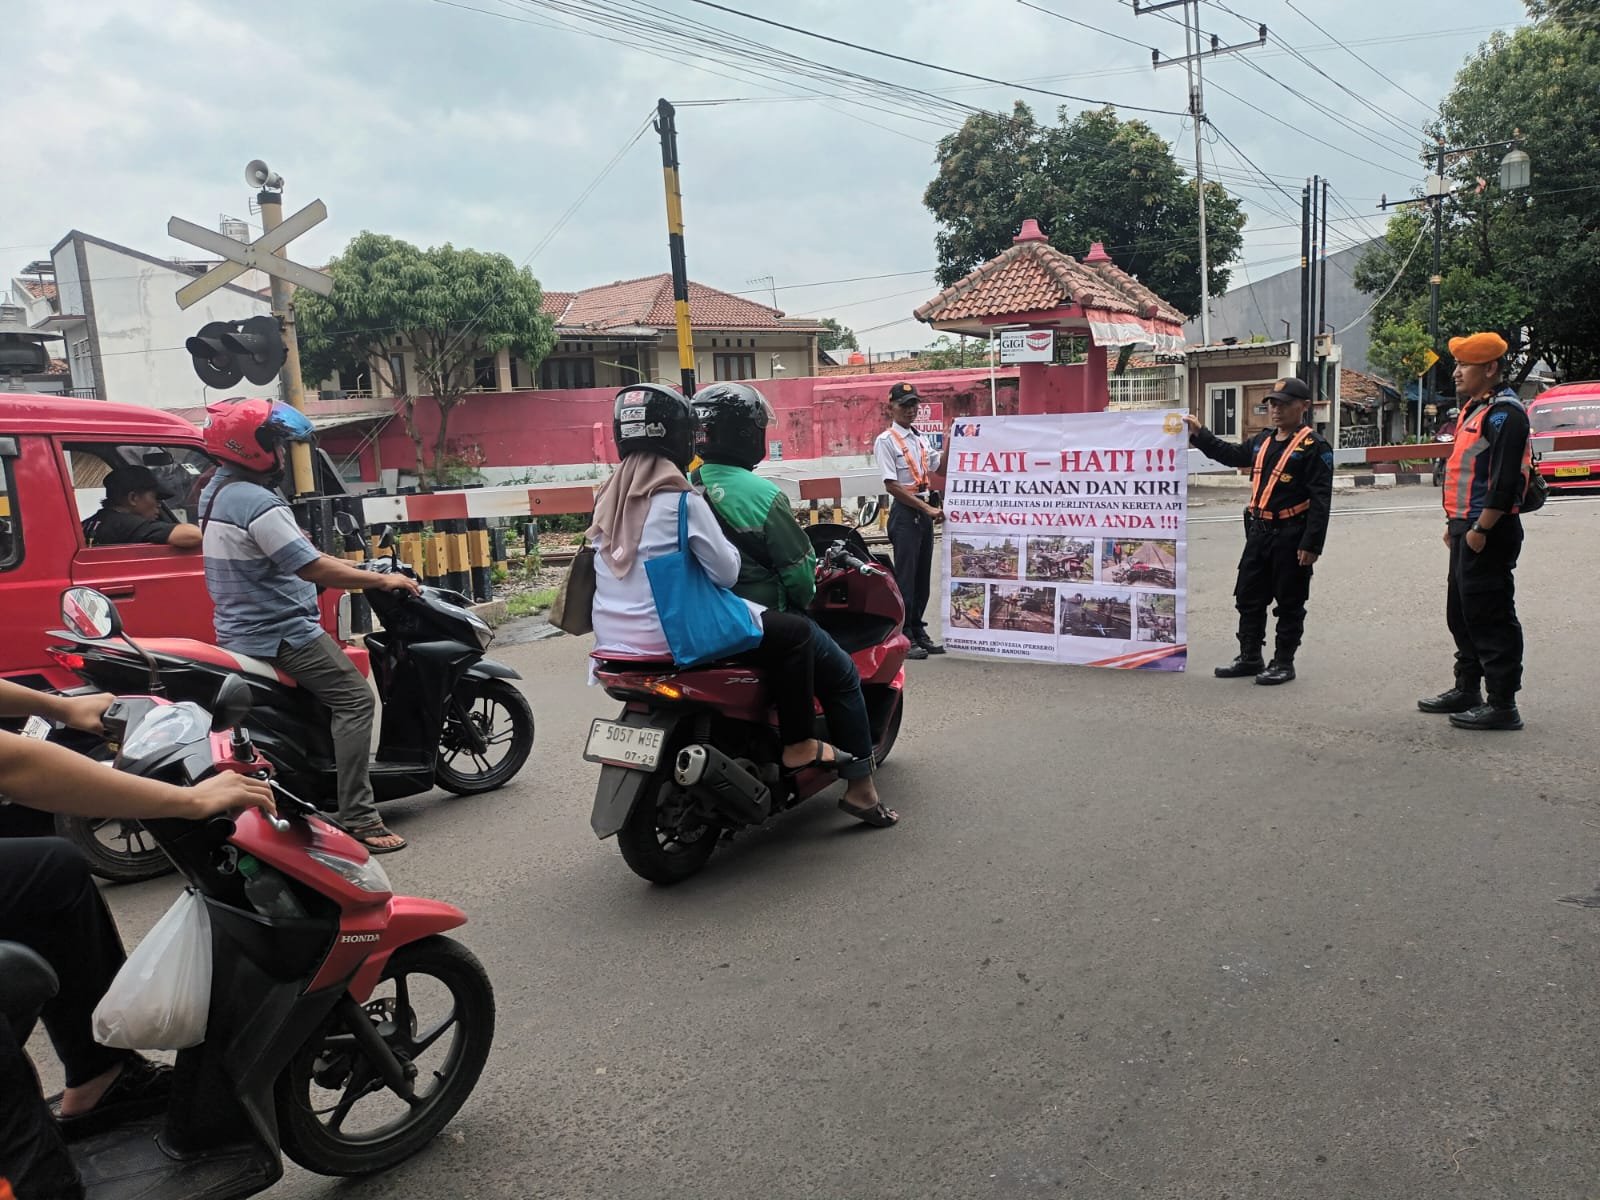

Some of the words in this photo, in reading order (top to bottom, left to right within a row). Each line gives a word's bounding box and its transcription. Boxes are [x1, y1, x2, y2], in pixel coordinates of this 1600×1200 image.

[1002, 340, 1024, 348] GIGI
[957, 452, 1028, 472] HATI
[1060, 450, 1136, 472] HATI
[1145, 448, 1176, 472] !!!
[952, 479, 1011, 494] LIHAT
[1014, 480, 1080, 495] KANAN
[1085, 480, 1128, 495] DAN
[1133, 480, 1180, 496] KIRI
[947, 499, 993, 507] SEBELUM
[995, 500, 1041, 508] MELINTAS
[1055, 501, 1119, 509] PERLINTASAN
[1121, 502, 1162, 510] KERETA
[1164, 502, 1182, 510] API
[949, 511, 1027, 525] SAYANGI
[1031, 513, 1097, 527] NYAWA
[1101, 514, 1156, 528] ANDA
[1160, 515, 1178, 529] !!!
[593, 723, 601, 738] F
[606, 725, 634, 744] 5057
[342, 934, 380, 943] HONDA
